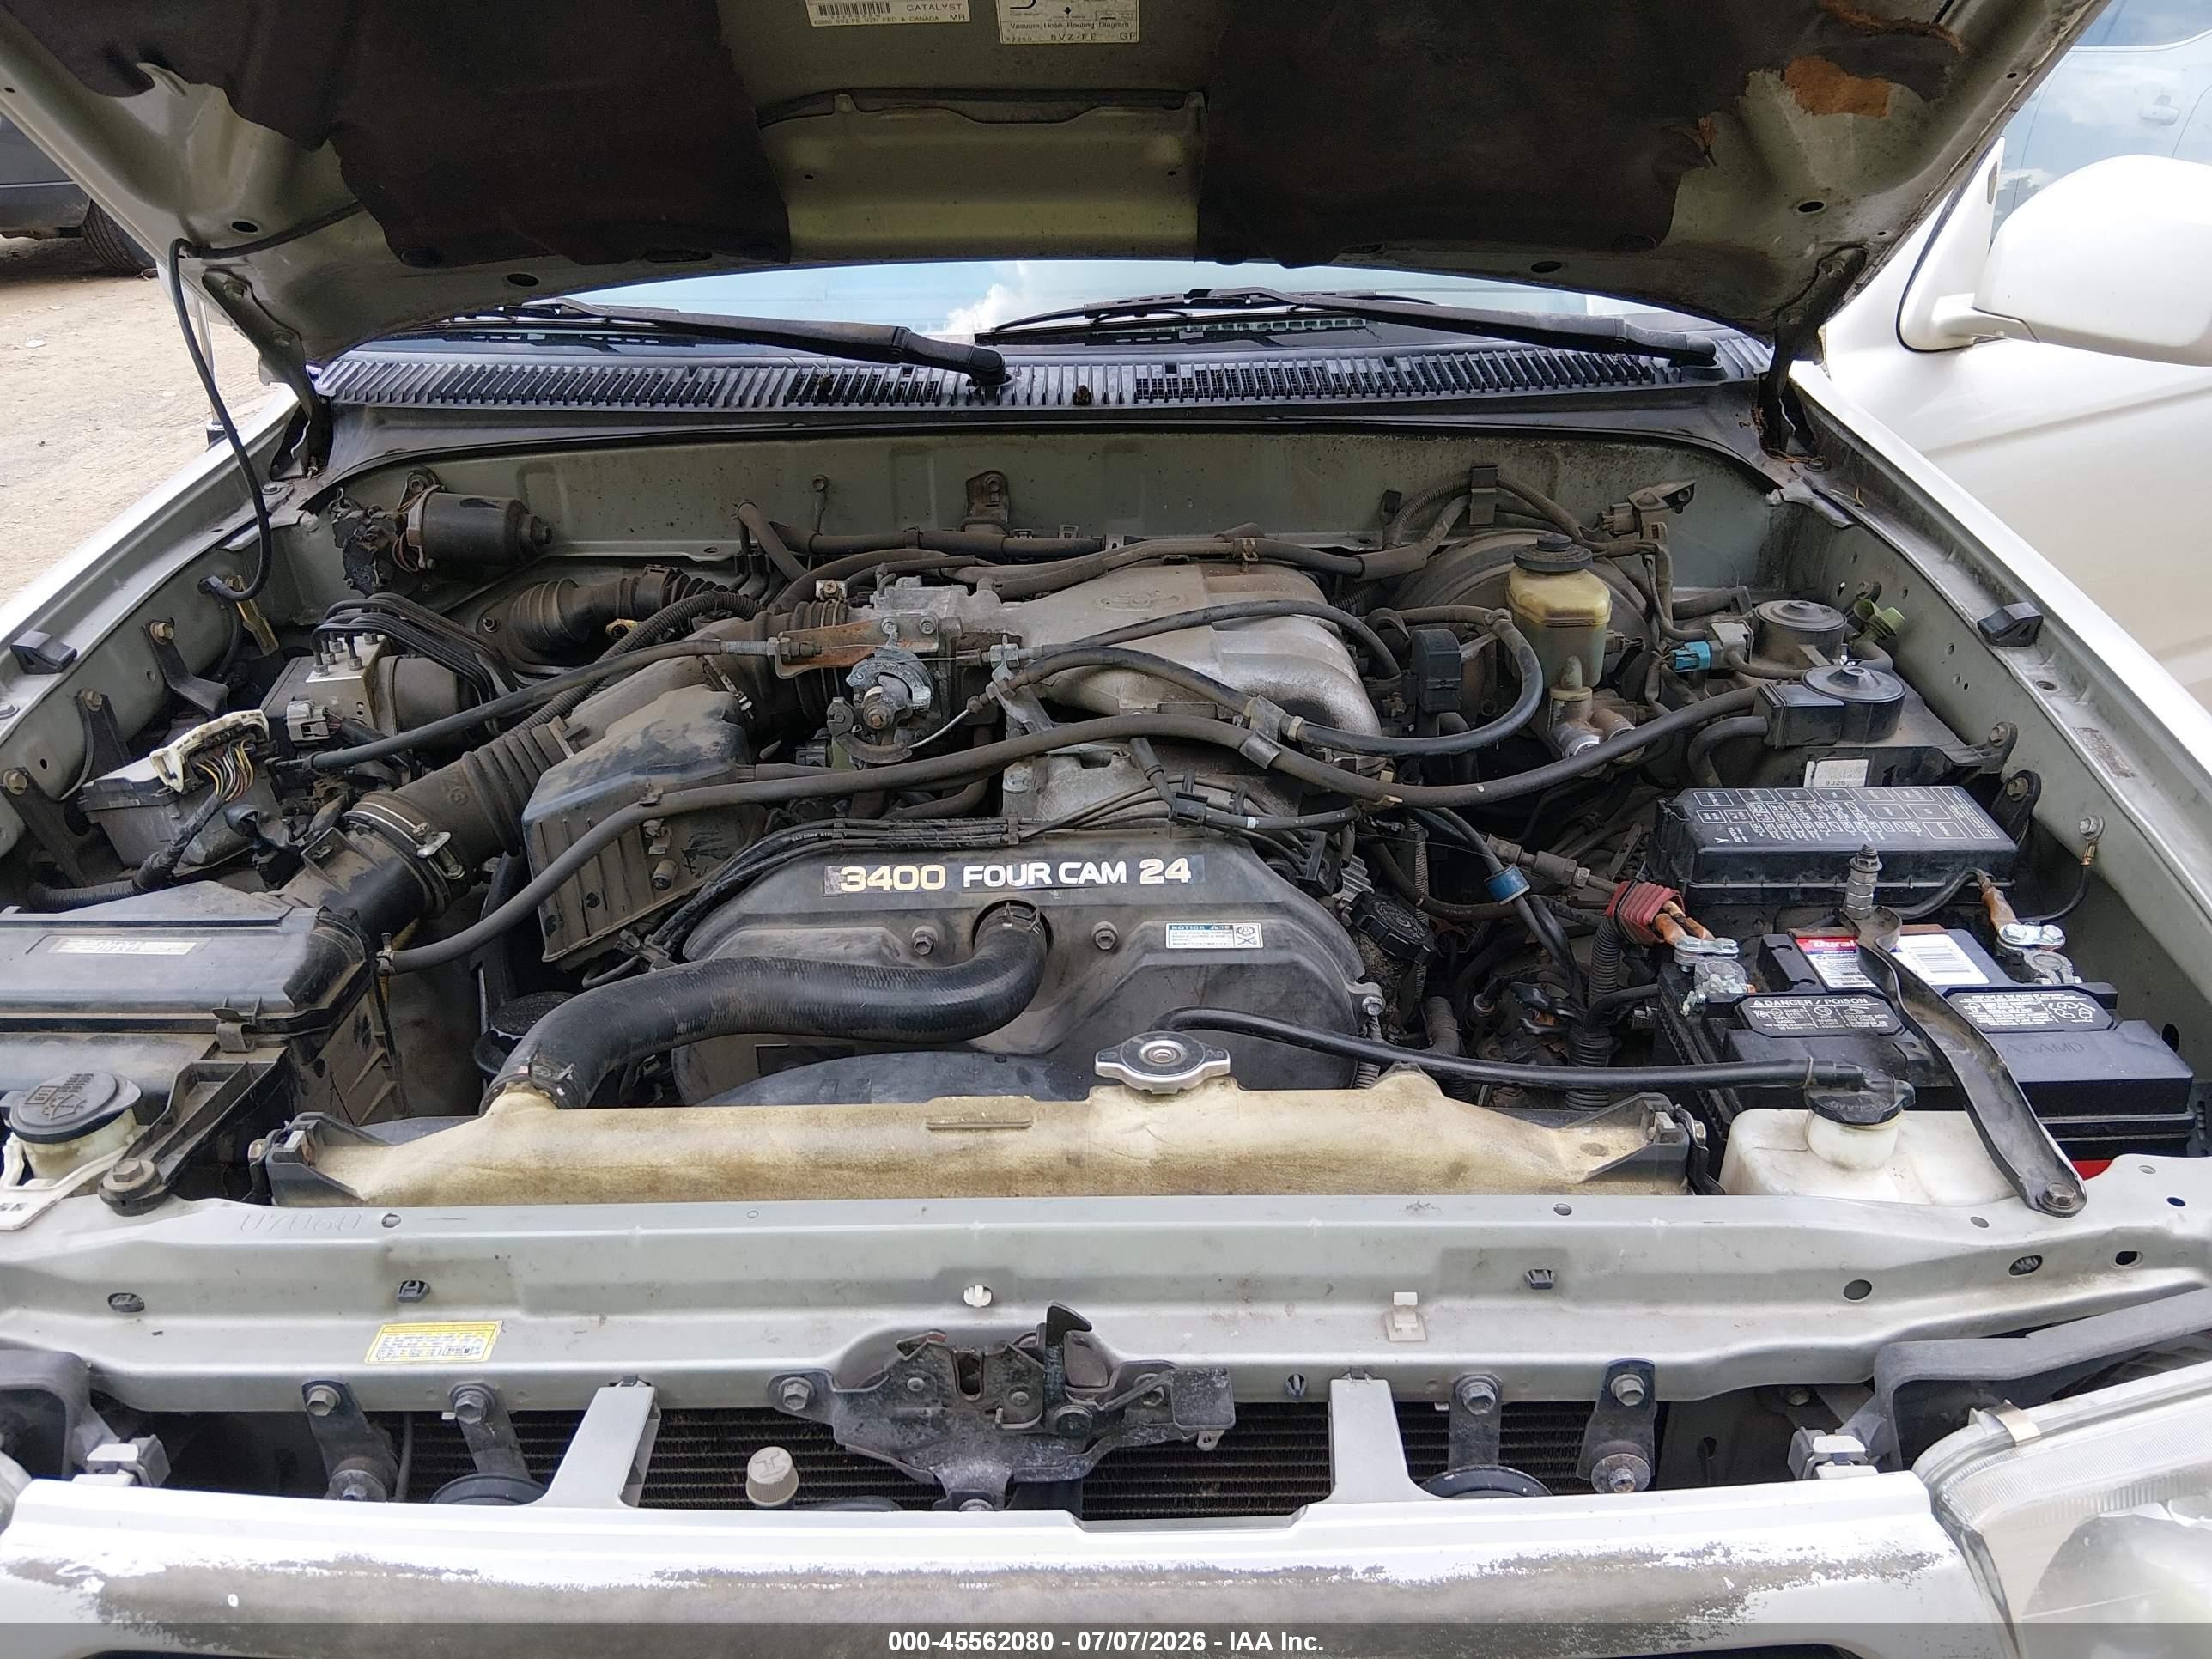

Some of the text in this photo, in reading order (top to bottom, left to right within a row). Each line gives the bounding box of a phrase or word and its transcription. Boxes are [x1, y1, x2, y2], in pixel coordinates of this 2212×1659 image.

[906, 3, 962, 12] CATALYST
[1043, 21, 1064, 29] Hose
[1066, 21, 1095, 29] Routing
[1098, 21, 1130, 30] Diagram
[840, 857, 1192, 892] 3400 FOUR CAM 24
[1764, 998, 1813, 1006] DANGER
[1823, 997, 1869, 1006] POISON
